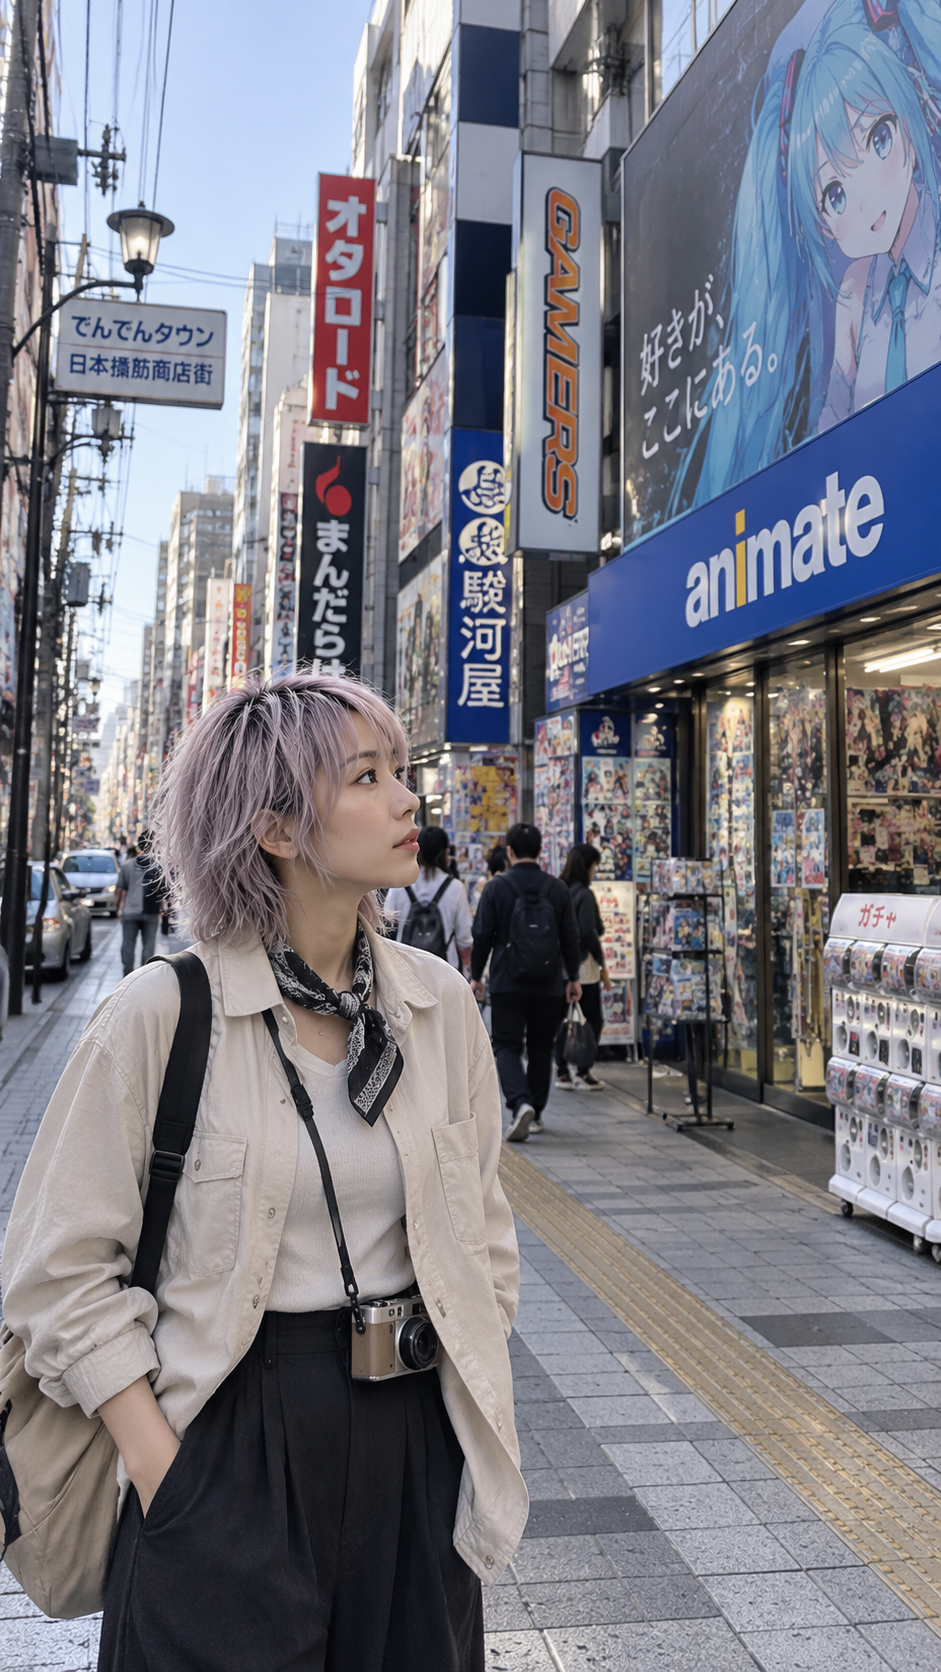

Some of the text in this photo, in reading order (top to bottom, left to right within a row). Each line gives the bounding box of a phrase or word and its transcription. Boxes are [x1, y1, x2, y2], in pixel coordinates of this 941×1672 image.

[71, 315, 214, 347] でんでんタウン
[325, 196, 367, 411] オタロード
[542, 187, 580, 520] GAMERS
[640, 273, 724, 396] 好きが、
[641, 321, 778, 459] ここにある。
[685, 471, 884, 628] animate
[858, 903, 897, 929] ガチャ
